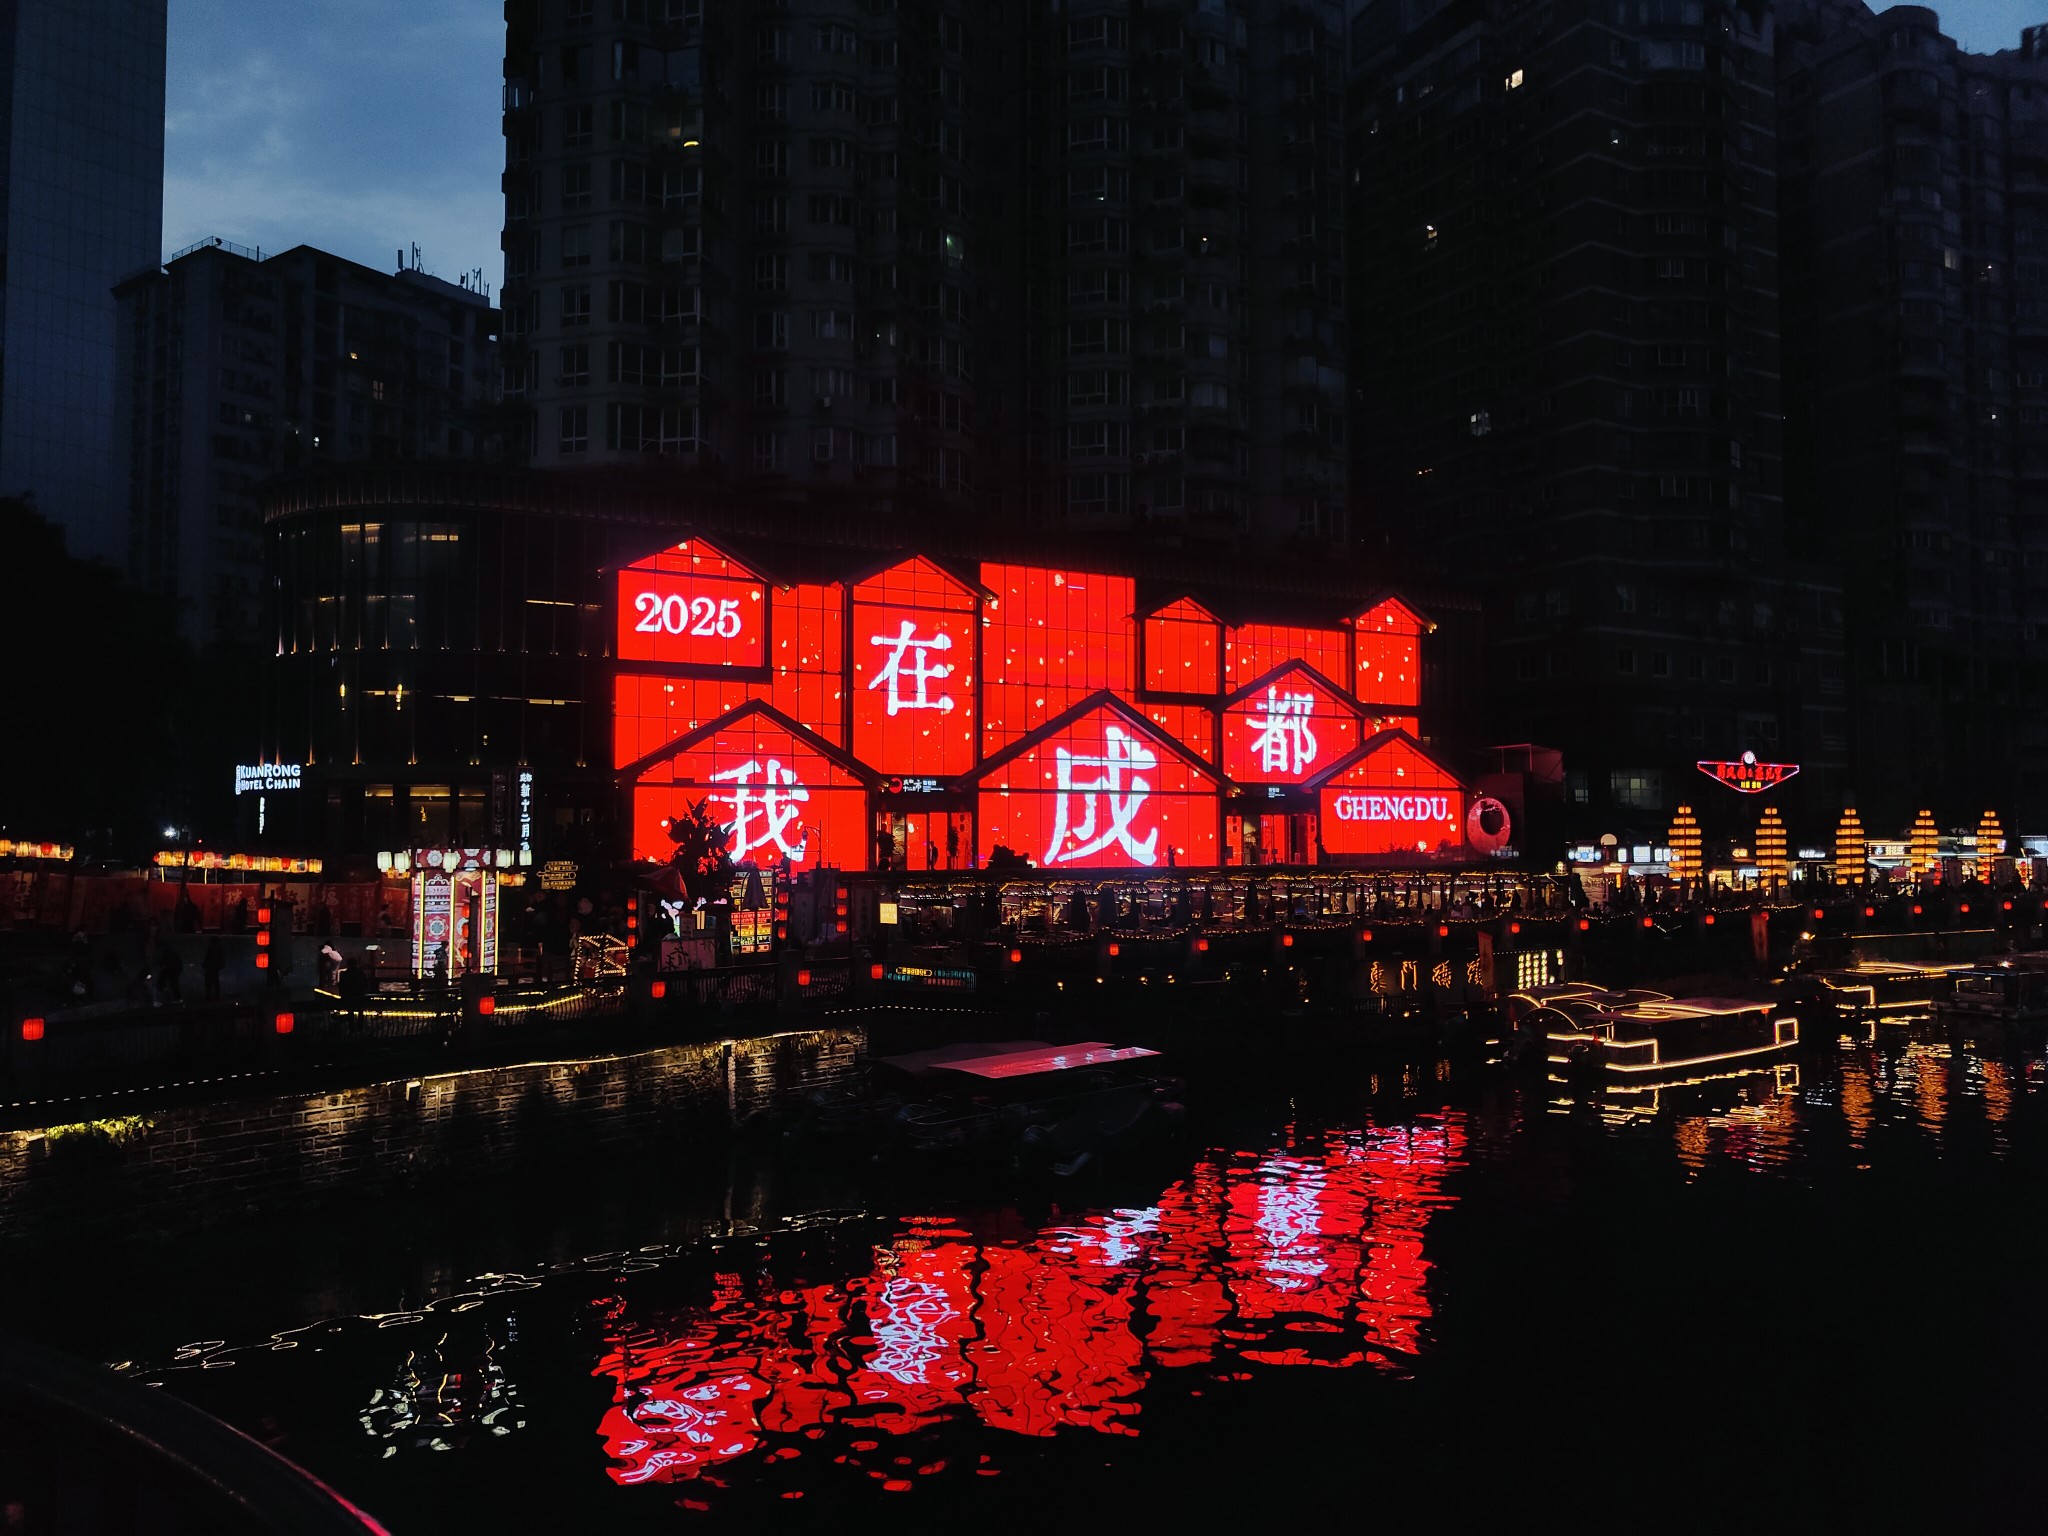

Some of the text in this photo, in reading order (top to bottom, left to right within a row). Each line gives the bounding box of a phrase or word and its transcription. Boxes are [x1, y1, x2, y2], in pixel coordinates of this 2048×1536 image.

[635, 592, 741, 638] 2025
[869, 620, 955, 716] 在
[1246, 685, 1317, 775] 都
[240, 779, 264, 791] HOTEL
[265, 777, 301, 790] CHAIN
[708, 759, 810, 865] 我
[1044, 726, 1159, 867] 成
[1334, 796, 1447, 821] CHENGDU
